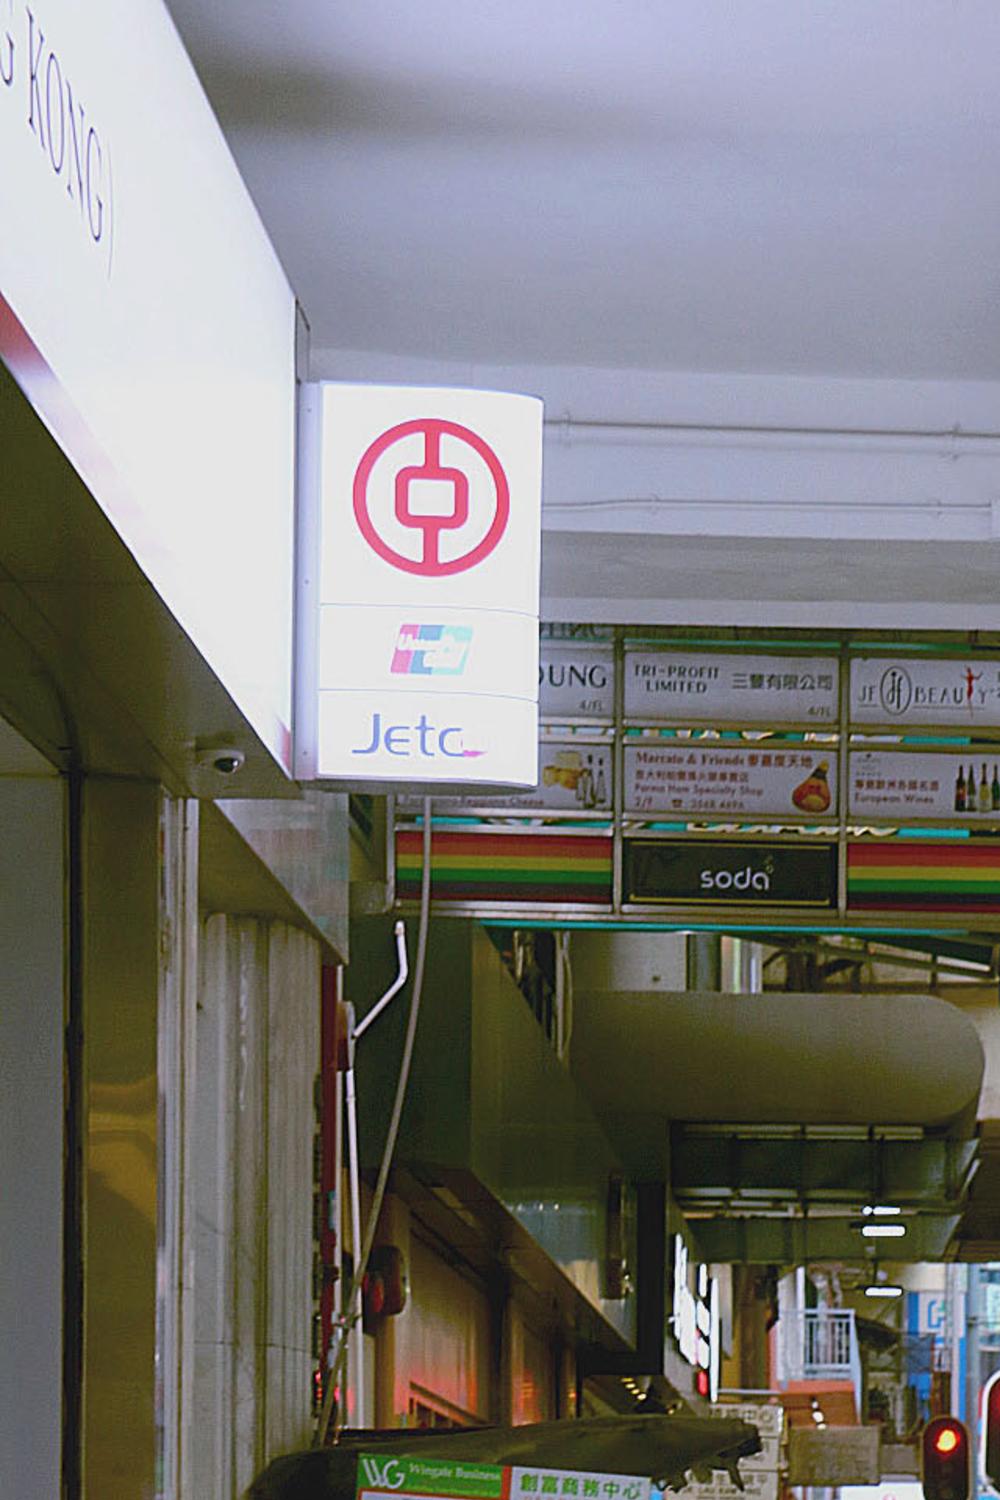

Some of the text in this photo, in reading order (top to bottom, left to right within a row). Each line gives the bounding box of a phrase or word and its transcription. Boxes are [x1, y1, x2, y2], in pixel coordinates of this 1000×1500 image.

[539, 664, 607, 689] UNG
[646, 680, 708, 694] LIMITED
[855, 792, 901, 806] European
[701, 866, 770, 891] soda
